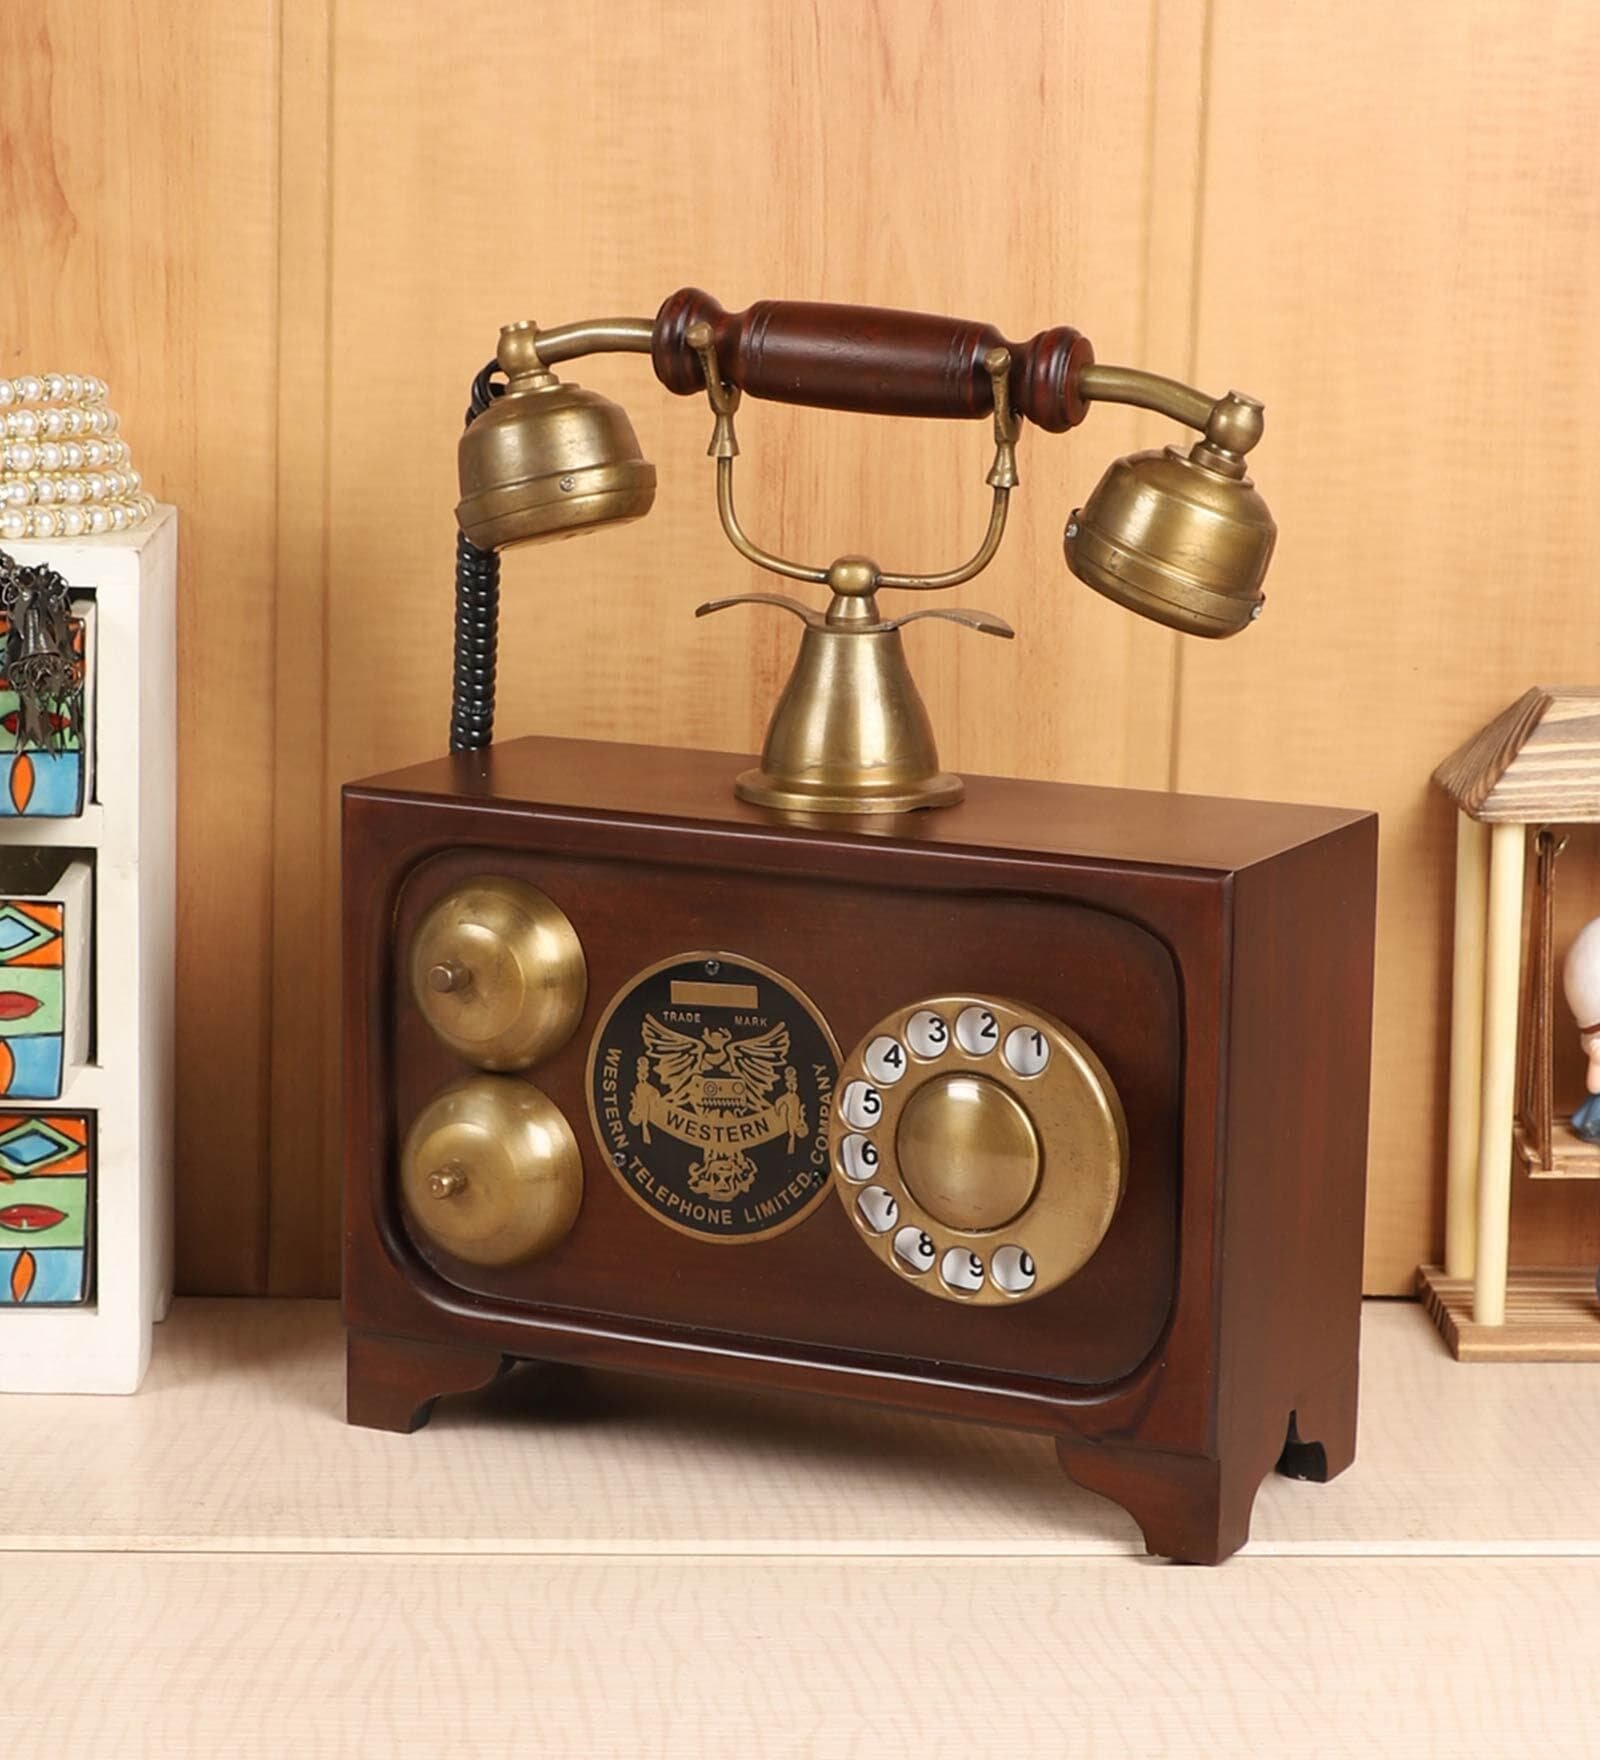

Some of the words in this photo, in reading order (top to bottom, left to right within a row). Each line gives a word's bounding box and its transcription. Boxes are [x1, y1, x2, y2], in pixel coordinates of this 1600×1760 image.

[662, 1010, 701, 1023] TRADE
[734, 1015, 768, 1027] MARK
[928, 1017, 946, 1043] 3
[980, 1012, 997, 1039] 2
[883, 1044, 903, 1069] 4
[1031, 1031, 1042, 1057] 1
[862, 1089, 881, 1115] 5
[602, 1047, 630, 1149] WESTERN
[628, 1154, 733, 1225] TELEPHONE
[743, 1171, 813, 1224] LIMITED
[809, 1062, 833, 1165] COMPANY
[665, 1110, 770, 1143] WESTERN
[861, 1140, 878, 1166] 6
[917, 1233, 935, 1257] 8
[969, 1253, 984, 1278] 9
